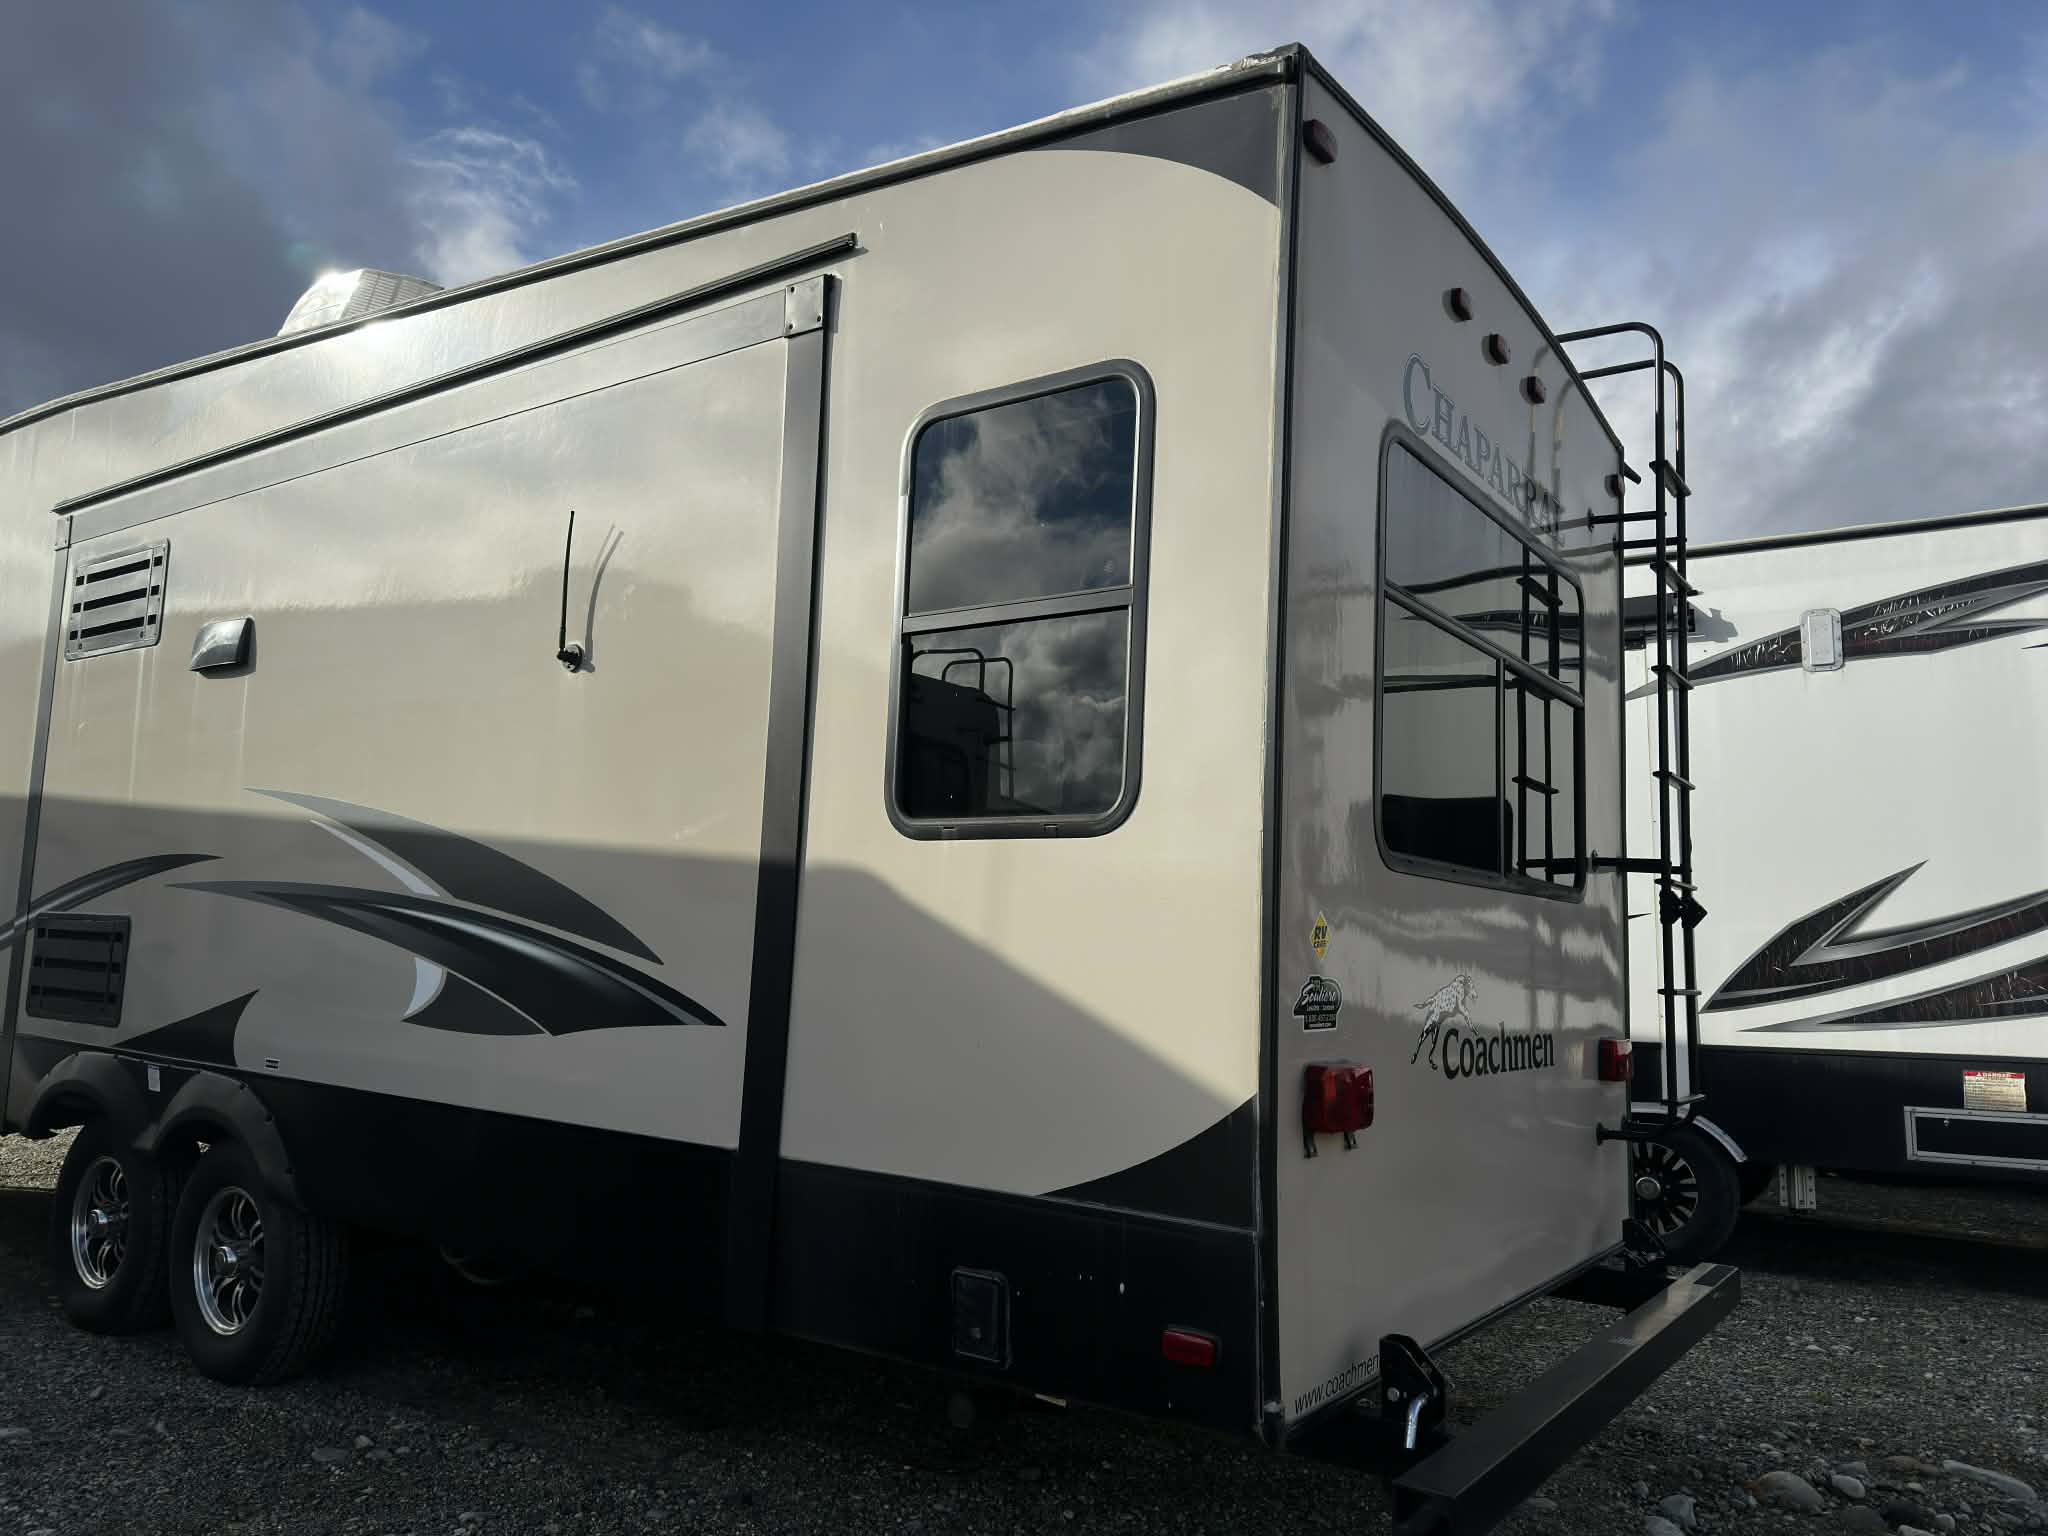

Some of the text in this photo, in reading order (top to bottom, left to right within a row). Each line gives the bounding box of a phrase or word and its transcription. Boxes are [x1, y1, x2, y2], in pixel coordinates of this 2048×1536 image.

[1403, 352, 1565, 547] CHAPARRAL
[1314, 926, 1328, 940] RV
[1442, 1022, 1555, 1080] Coachmen
